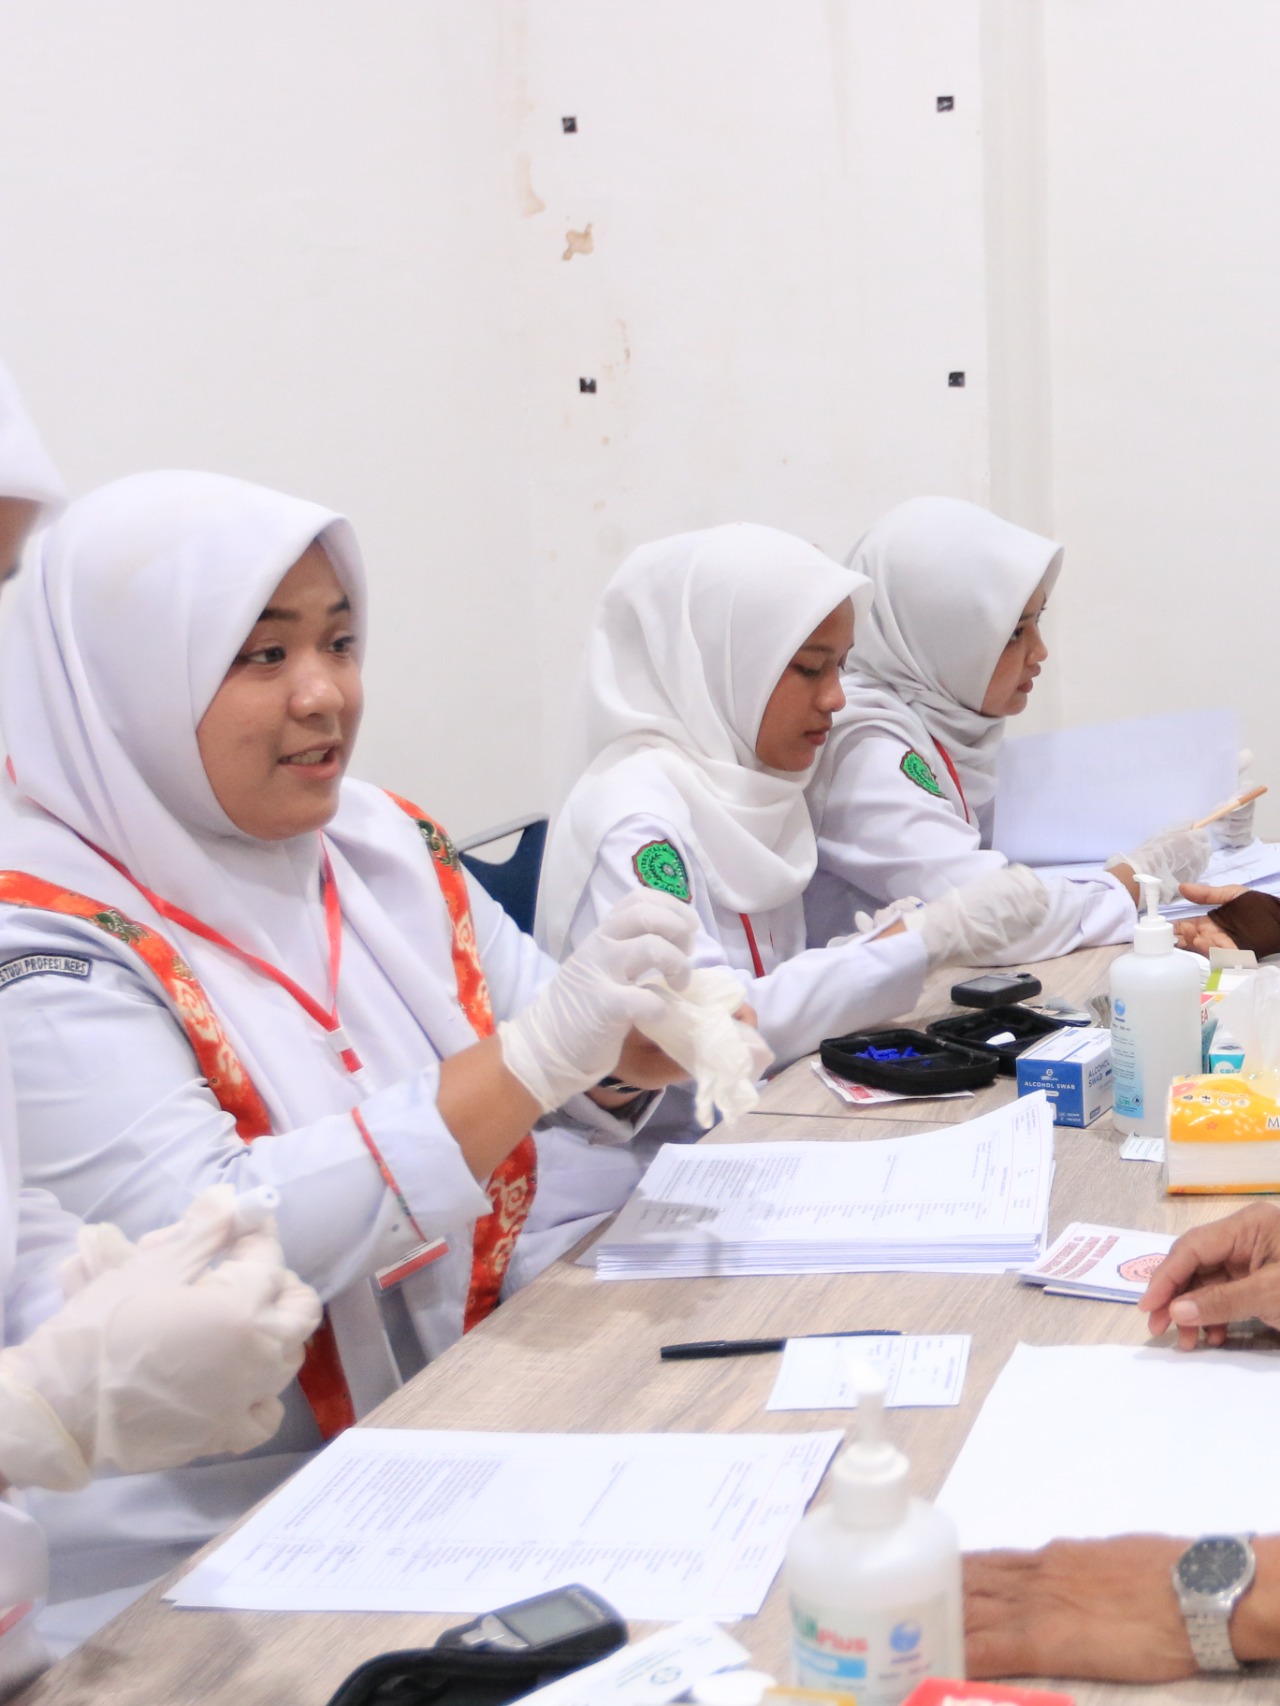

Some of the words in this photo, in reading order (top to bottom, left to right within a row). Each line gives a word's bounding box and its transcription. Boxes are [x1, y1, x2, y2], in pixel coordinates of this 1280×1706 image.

[24, 957, 62, 973] PROFESI
[64, 959, 86, 974] NERS
[1089, 1058, 1110, 1078] ALCOHOL
[1024, 1081, 1055, 1089] ALCOHOL
[1089, 1072, 1103, 1088] SWAB
